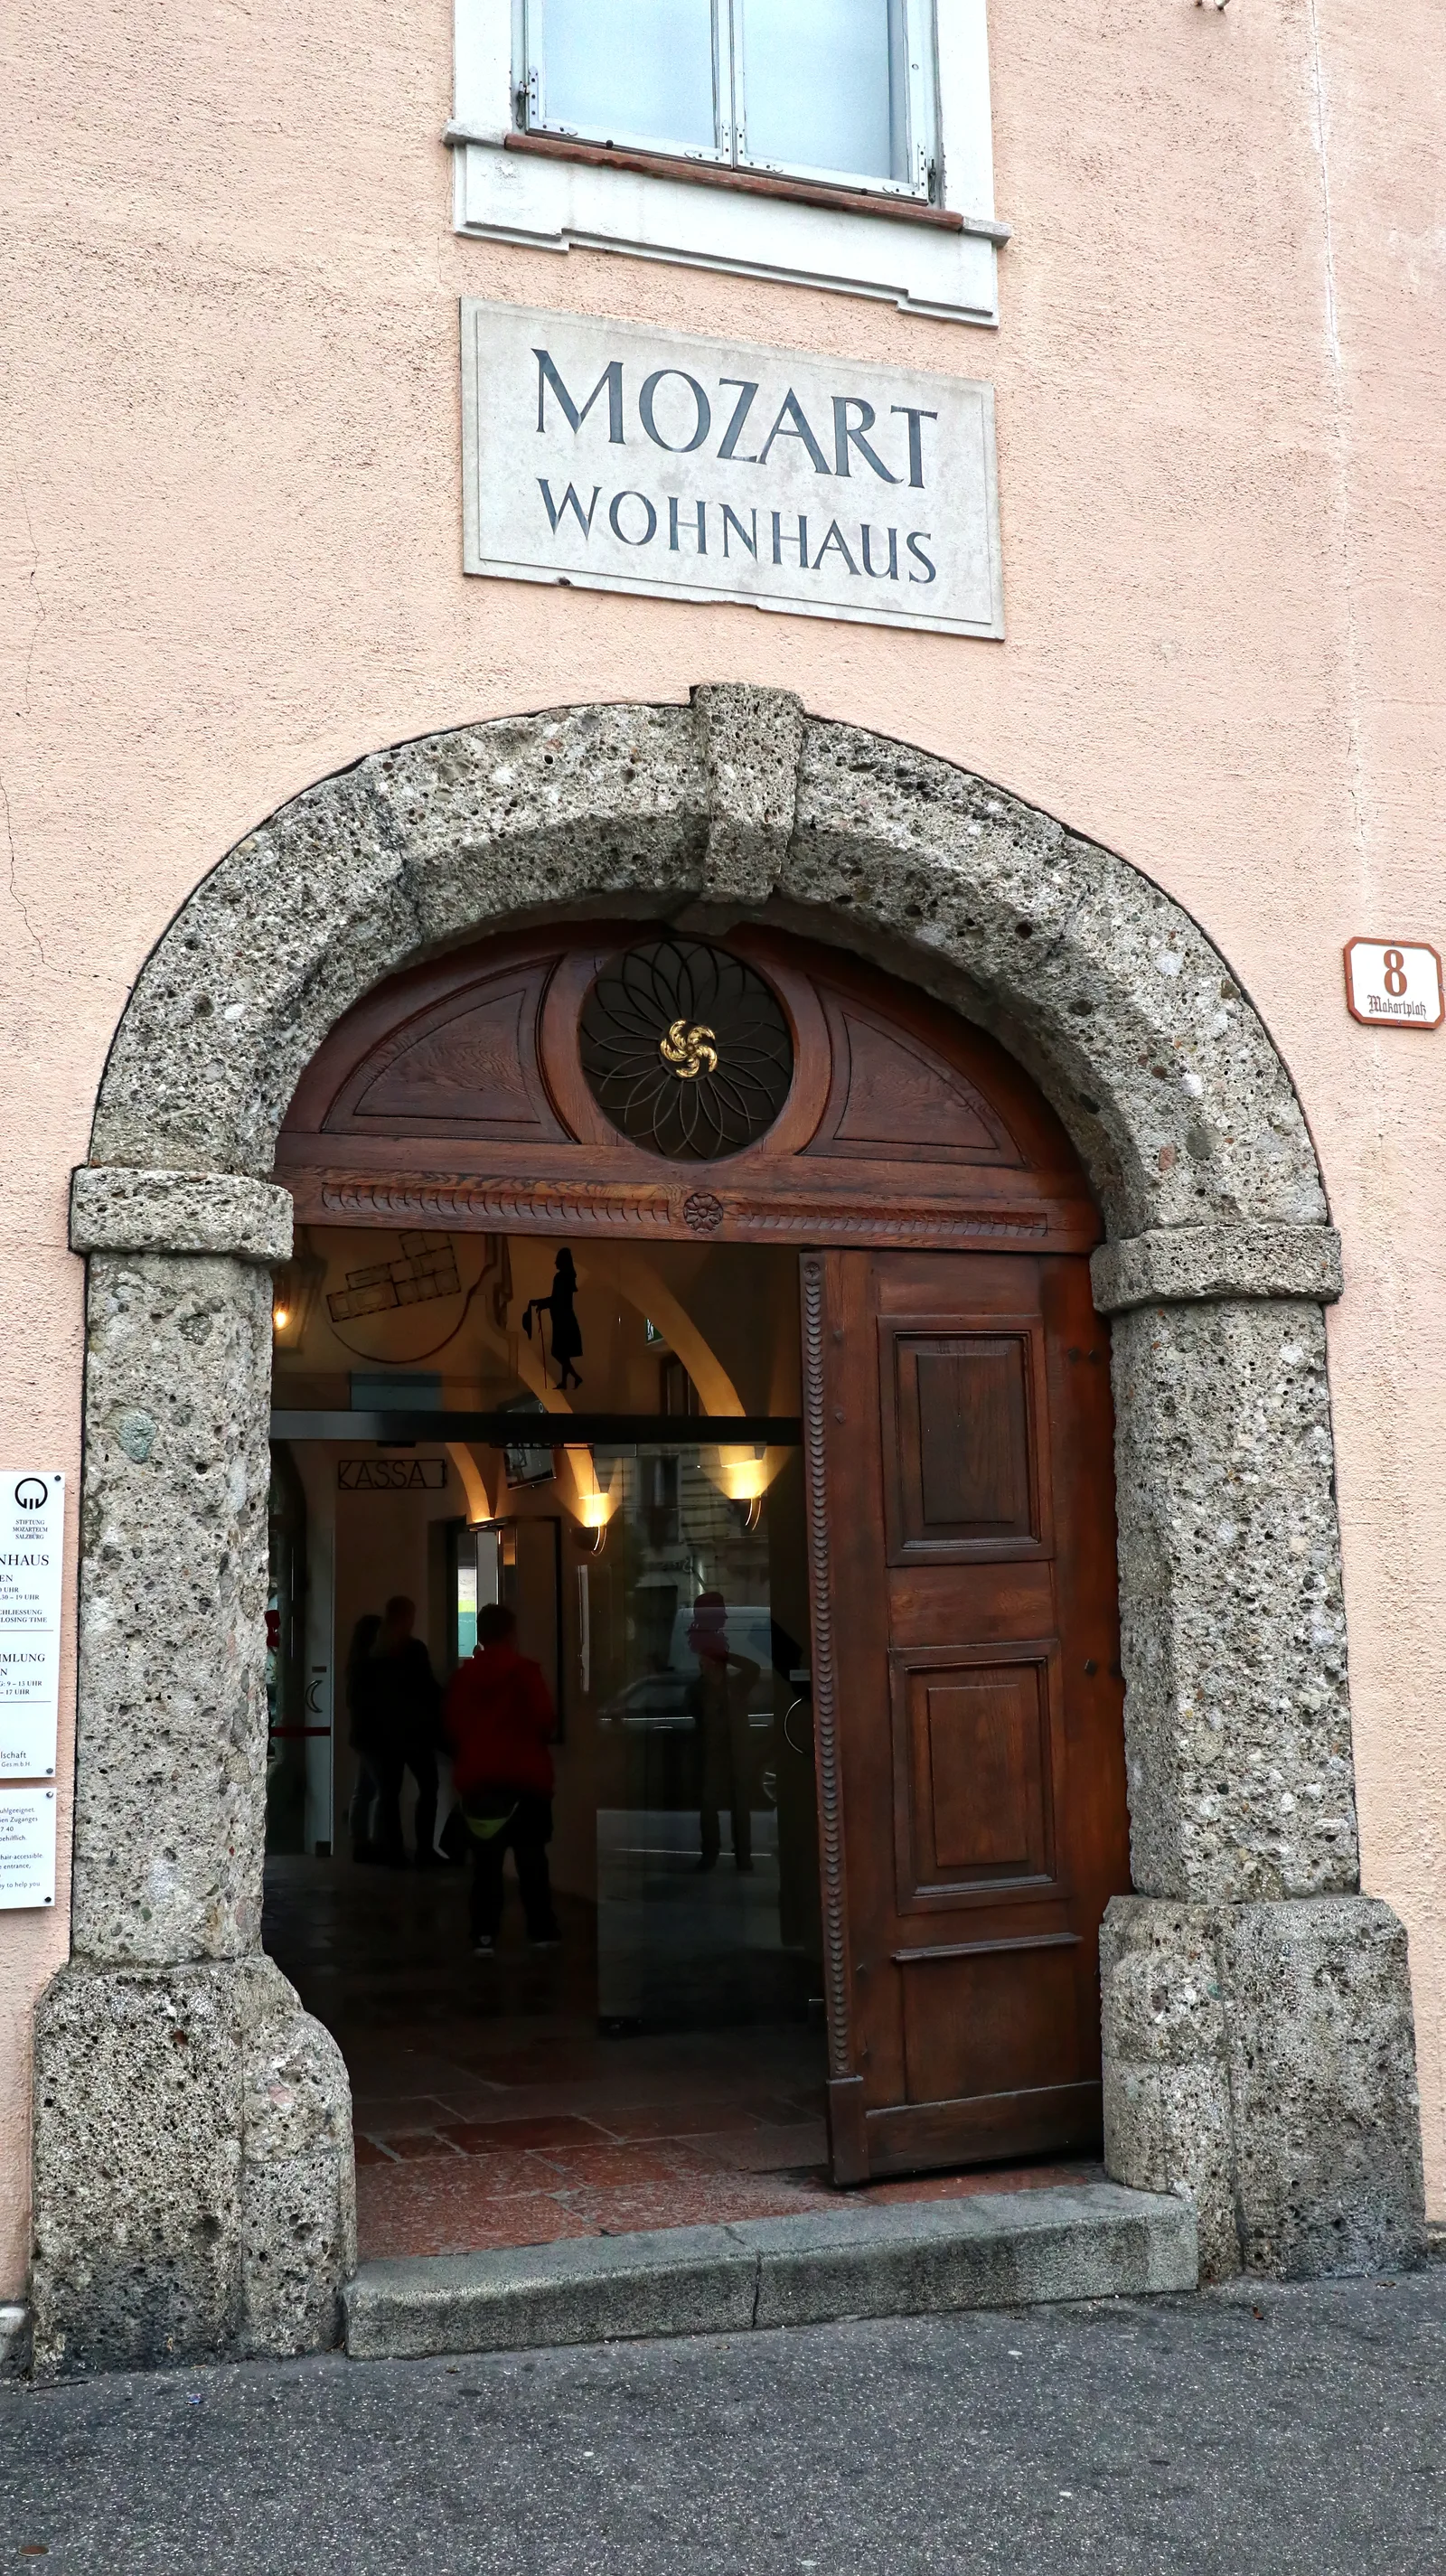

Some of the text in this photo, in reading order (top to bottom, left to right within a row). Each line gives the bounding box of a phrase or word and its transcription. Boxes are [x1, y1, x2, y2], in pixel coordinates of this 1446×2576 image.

[531, 348, 938, 488] MOZART
[535, 478, 936, 584] WOHNHAUS
[1383, 949, 1407, 997] 8
[1367, 994, 1427, 1020] Makartplatz
[339, 1461, 428, 1489] KASSA
[10, 1816, 38, 1824] Zuganges
